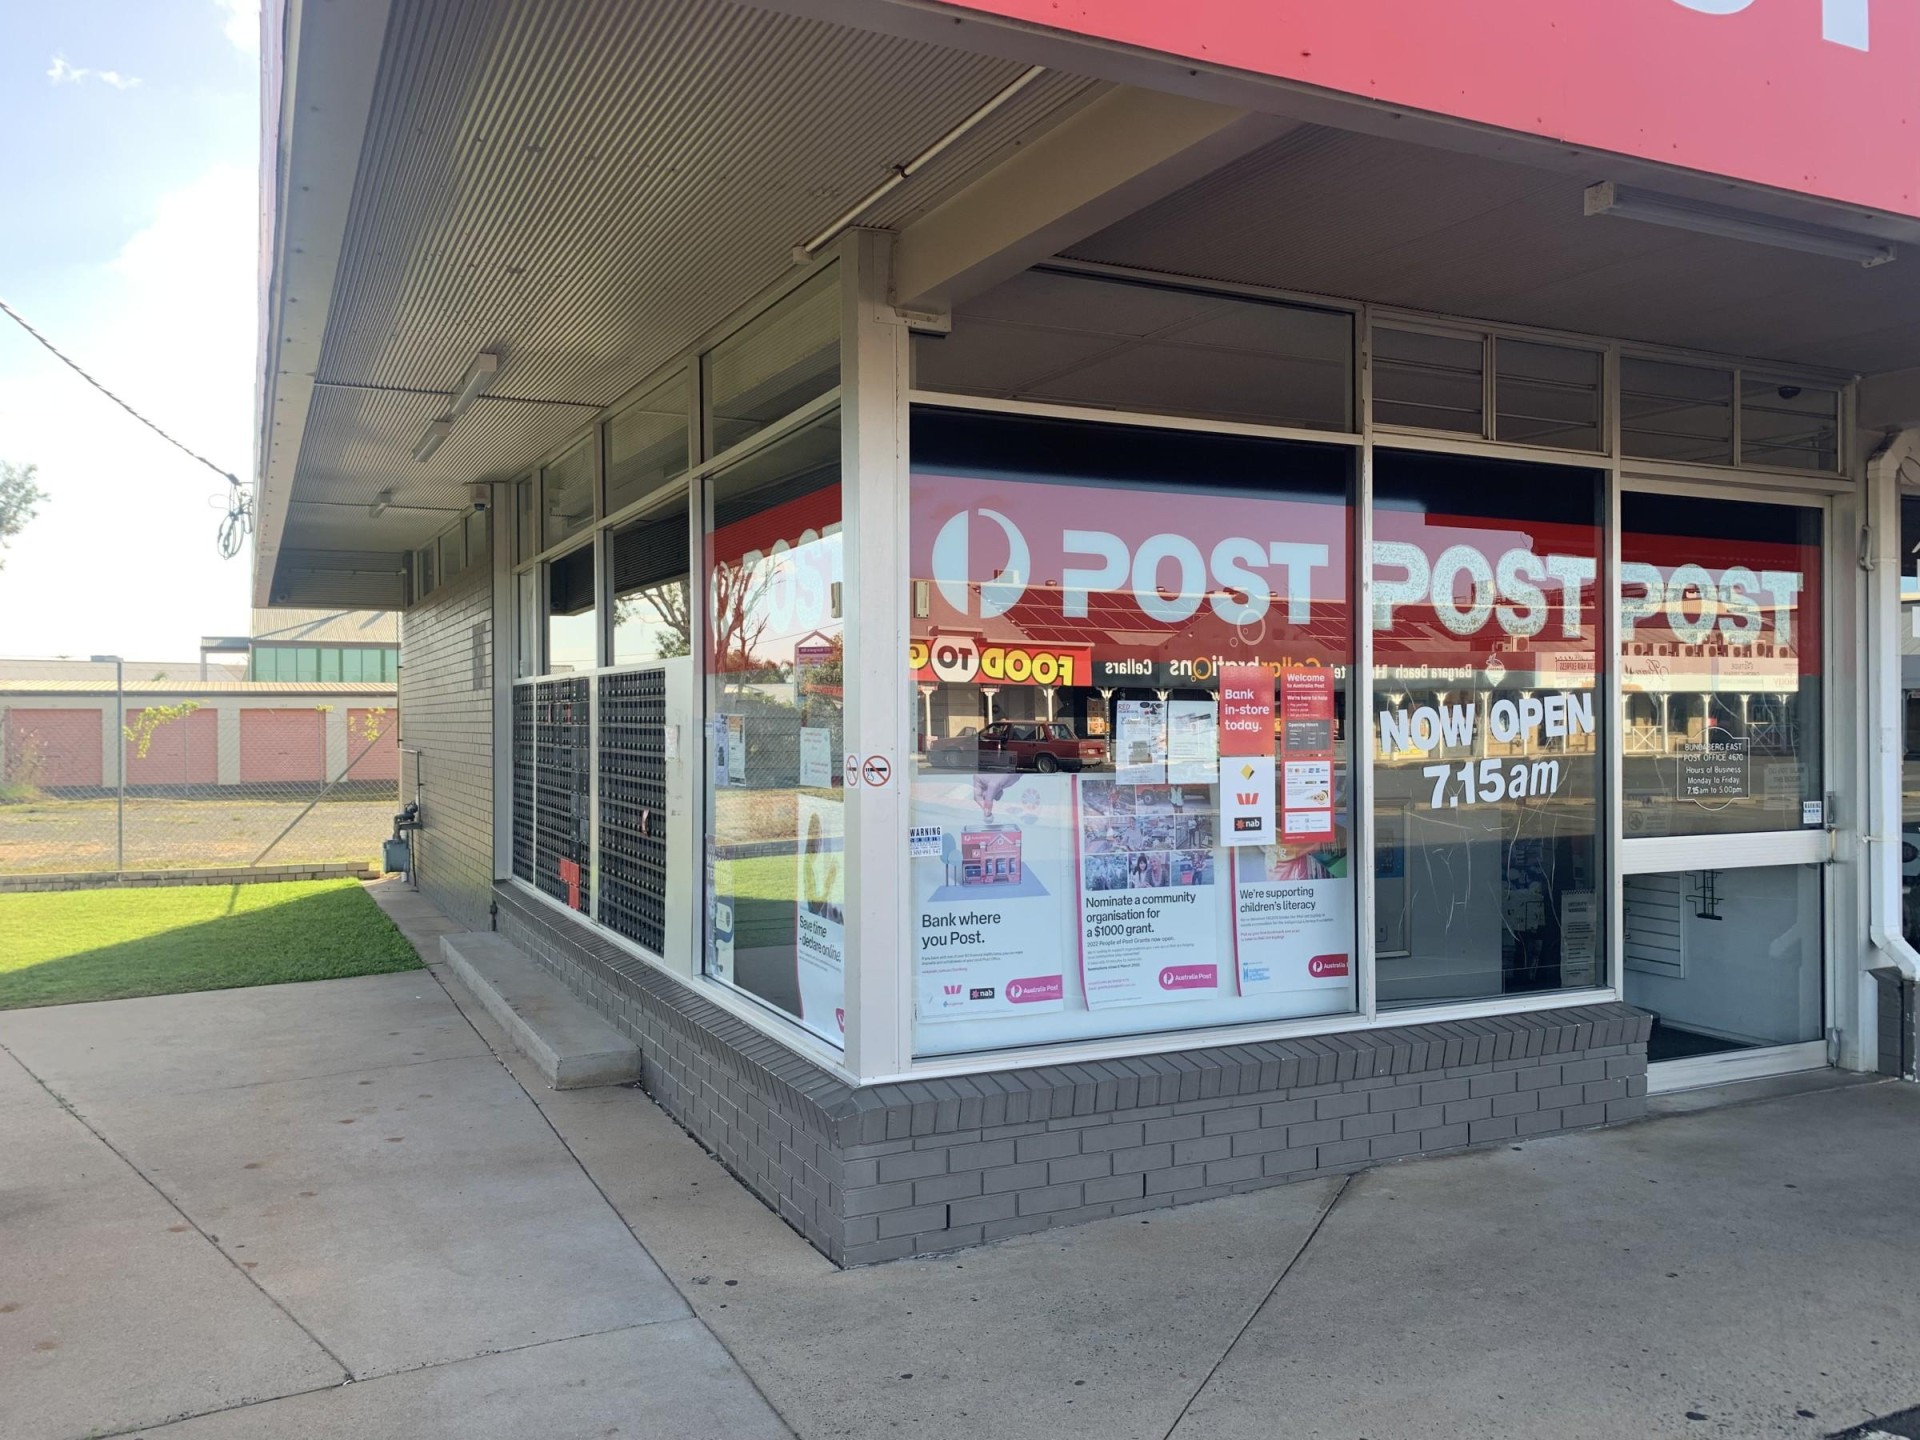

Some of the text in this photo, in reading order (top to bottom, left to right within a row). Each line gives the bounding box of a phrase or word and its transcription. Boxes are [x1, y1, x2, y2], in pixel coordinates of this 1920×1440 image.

[1063, 529, 1329, 625] POST
[1372, 540, 1597, 639] POST
[1621, 561, 1804, 647] POST
[1286, 673, 1325, 682] Welcome
[1225, 689, 1254, 700] Bank
[1225, 704, 1270, 715] in-store
[1225, 719, 1262, 733] today.
[1379, 692, 1594, 753] NOW OPEN
[1725, 742, 1742, 751] EAST
[1683, 753, 1744, 762] POST OFFICE 4670
[1685, 766, 1704, 774] Hours
[1714, 765, 1741, 773] Business
[1423, 758, 1560, 809] 7.15am
[1687, 776, 1711, 785] Monday
[1721, 775, 1740, 785] Friday
[1245, 819, 1260, 828] nab
[910, 826, 941, 837] WARNING
[1086, 891, 1196, 908] Nominate a community
[1240, 887, 1314, 899] We're supporting
[1240, 900, 1316, 913] children's literacy
[922, 911, 1001, 928] Bank where
[1086, 907, 1161, 925] organisation for
[799, 915, 827, 938] Save time
[1086, 922, 1155, 938] a $1000 grant.
[801, 932, 822, 954] declare
[921, 930, 985, 950] you Post.
[979, 989, 994, 998] nab
[1023, 984, 1059, 994] Australia Post
